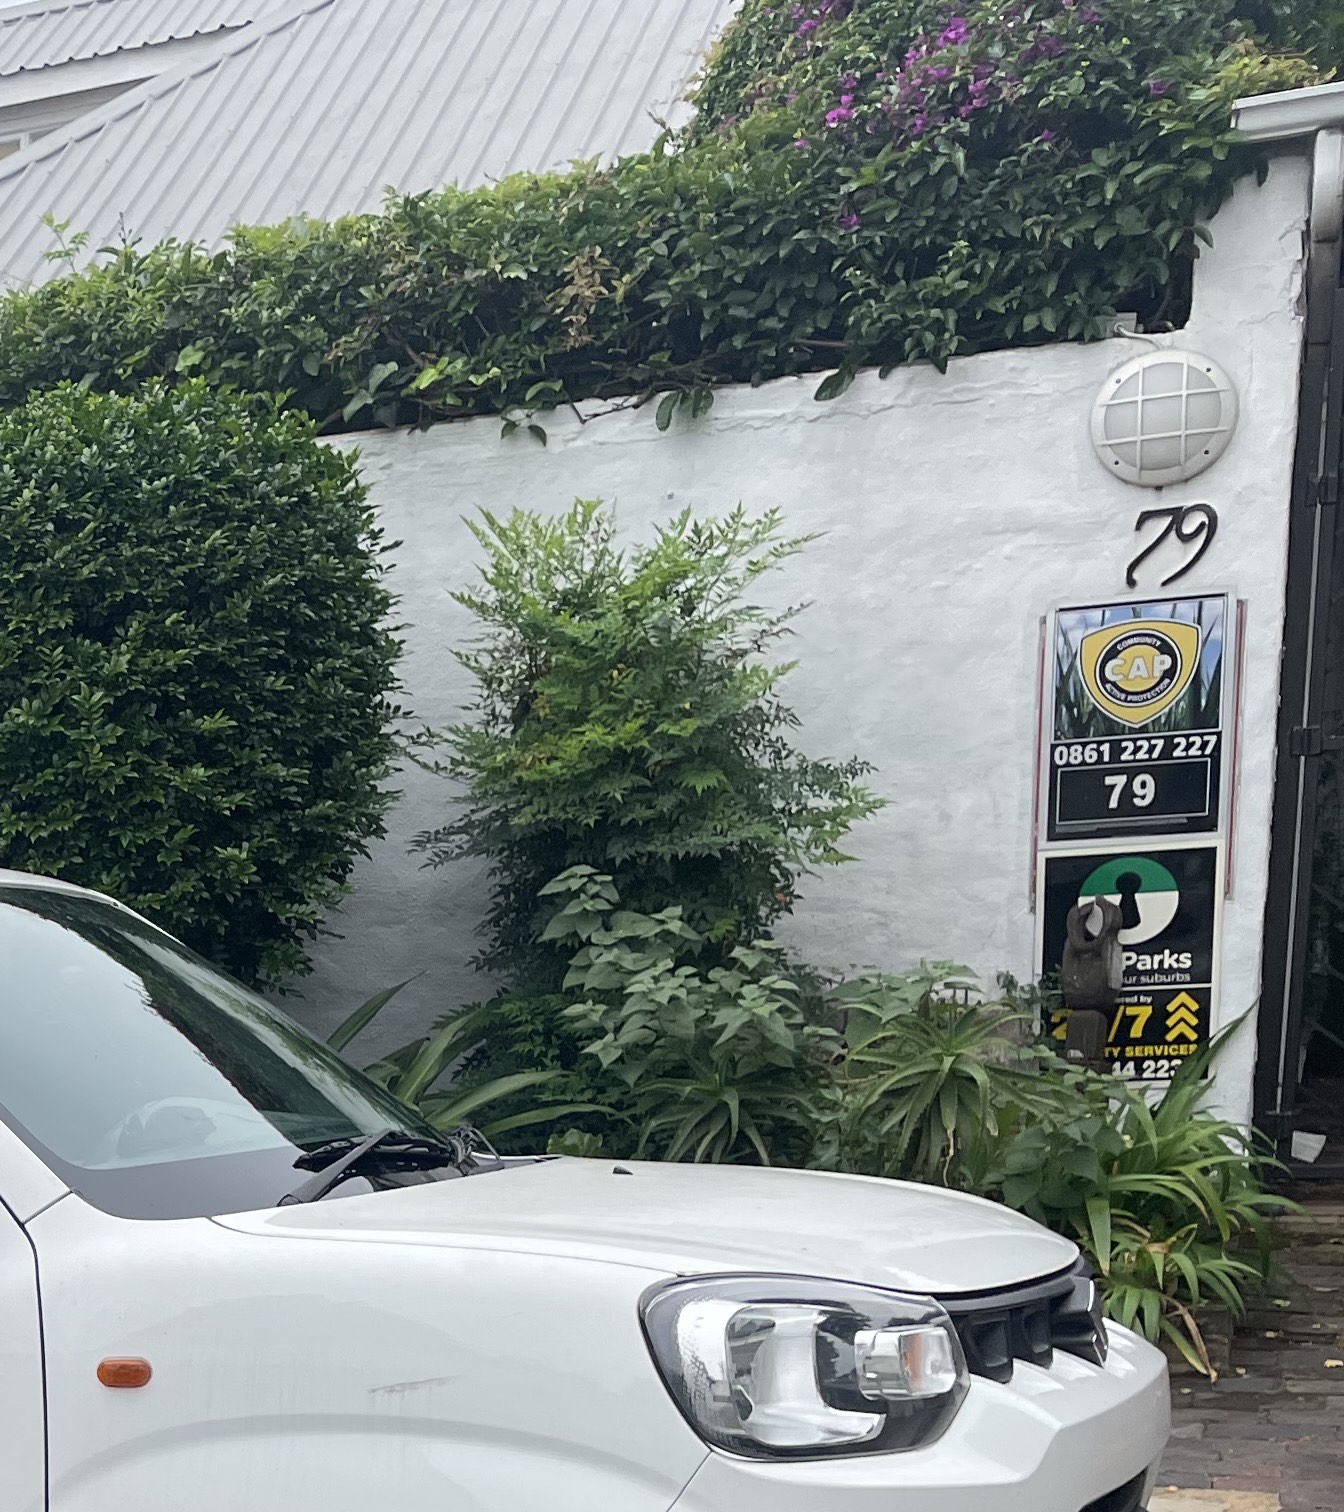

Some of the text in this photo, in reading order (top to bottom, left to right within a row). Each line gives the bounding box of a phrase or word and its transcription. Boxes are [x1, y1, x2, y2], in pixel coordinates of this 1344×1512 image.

[1126, 503, 1218, 588] 79
[1105, 654, 1172, 681] CAP
[1054, 735, 1217, 765] 0861 227 227
[1104, 773, 1156, 809] 79
[1121, 949, 1193, 971] Parks
[1140, 971, 1191, 984] suburbs
[1051, 1005, 1153, 1043] 2/7
